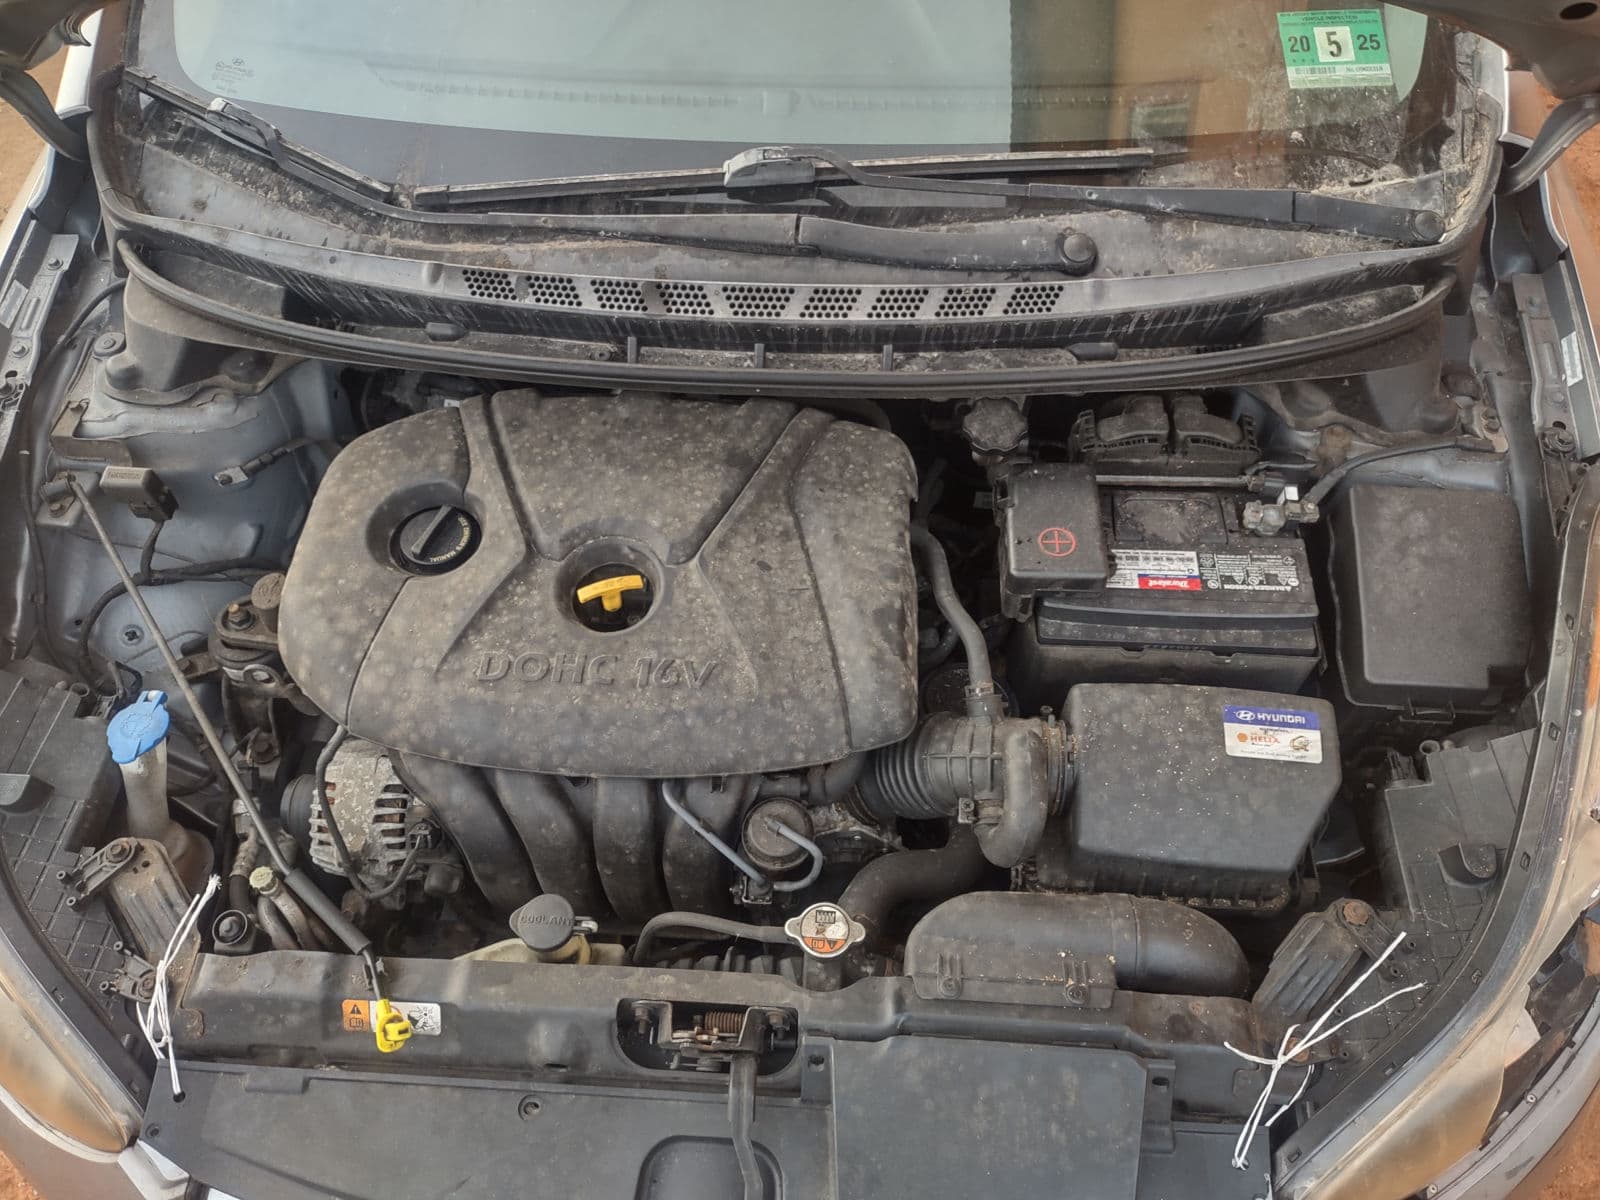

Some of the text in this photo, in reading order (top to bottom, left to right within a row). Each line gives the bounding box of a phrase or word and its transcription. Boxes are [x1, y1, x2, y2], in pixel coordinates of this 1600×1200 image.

[1288, 31, 1381, 58] 20 5 25
[477, 651, 719, 689] DOHC 16V
[1257, 713, 1306, 724] HYUNDAI
[1250, 735, 1280, 744] HELIX
[520, 914, 573, 926] COOLANT
